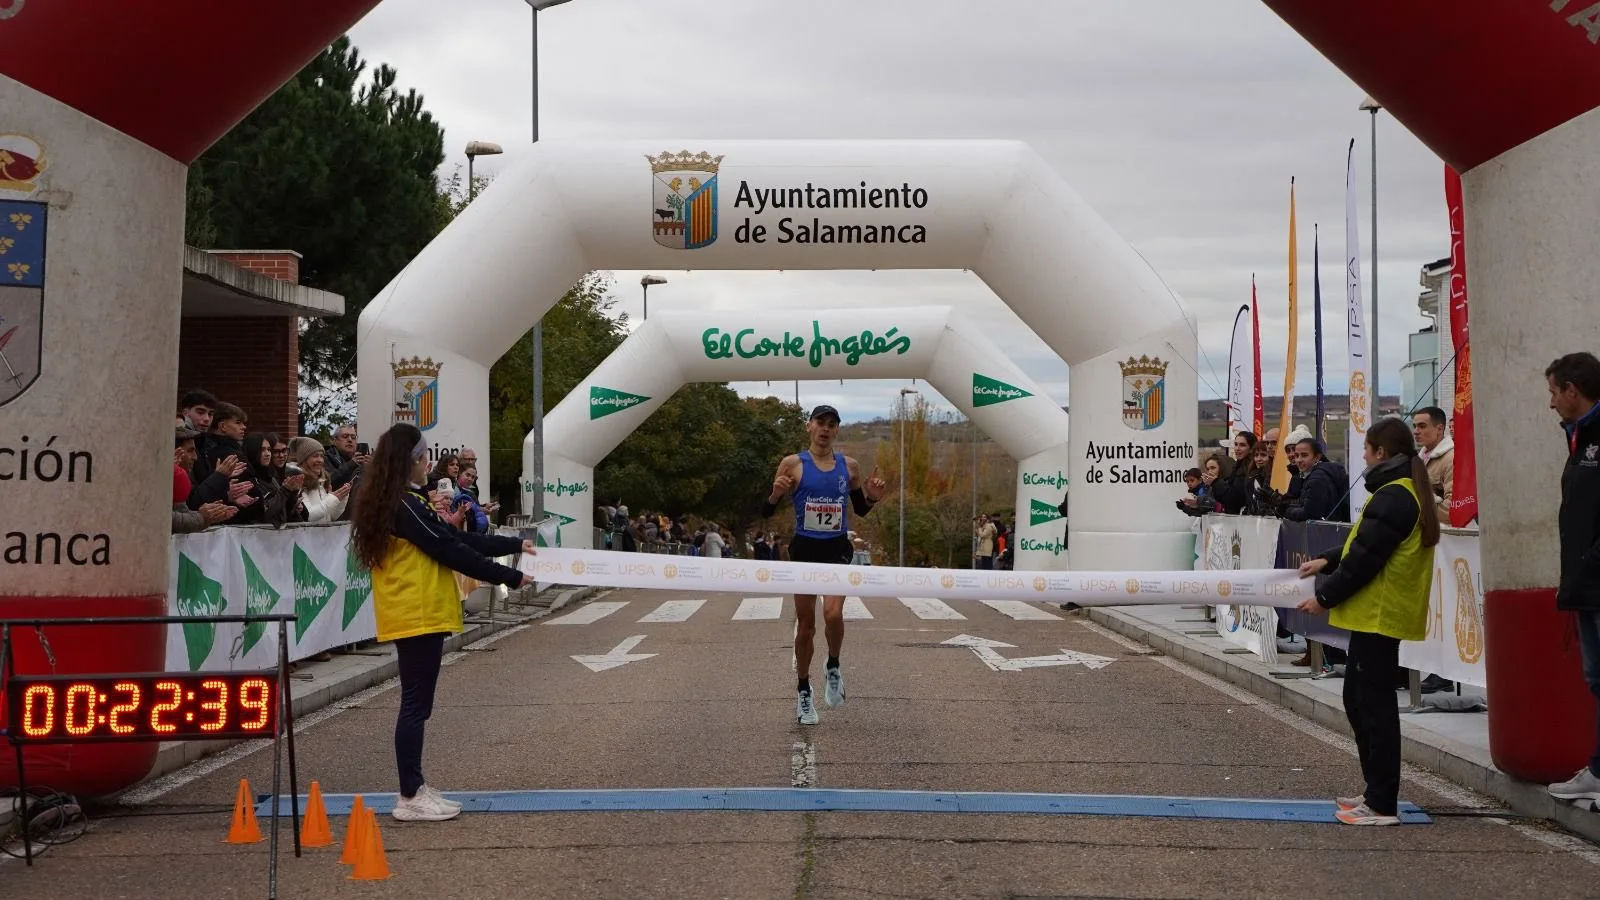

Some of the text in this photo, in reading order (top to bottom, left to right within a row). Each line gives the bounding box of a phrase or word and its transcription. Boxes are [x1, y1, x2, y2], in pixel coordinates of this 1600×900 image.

[733, 180, 929, 215] Ayuntamiento
[733, 217, 927, 244] de Salamanca
[702, 320, 911, 368] El Corte Inglés
[1086, 441, 1194, 463] Ayuntamiento
[1031, 473, 1055, 485] Corte
[1086, 464, 1188, 484] de Salamanc
[556, 477, 589, 497] Inglés
[816, 513, 833, 525] 12
[1029, 539, 1054, 551] Corte
[617, 564, 656, 576] UPSA
[710, 567, 748, 579] UPSA
[802, 571, 841, 583] UPSA
[987, 576, 1025, 588] UPSA
[1080, 579, 1118, 592] UPSA
[1172, 581, 1210, 594] UPSA
[1264, 583, 1301, 597] UPSA
[24, 679, 269, 736] 00:22:39
